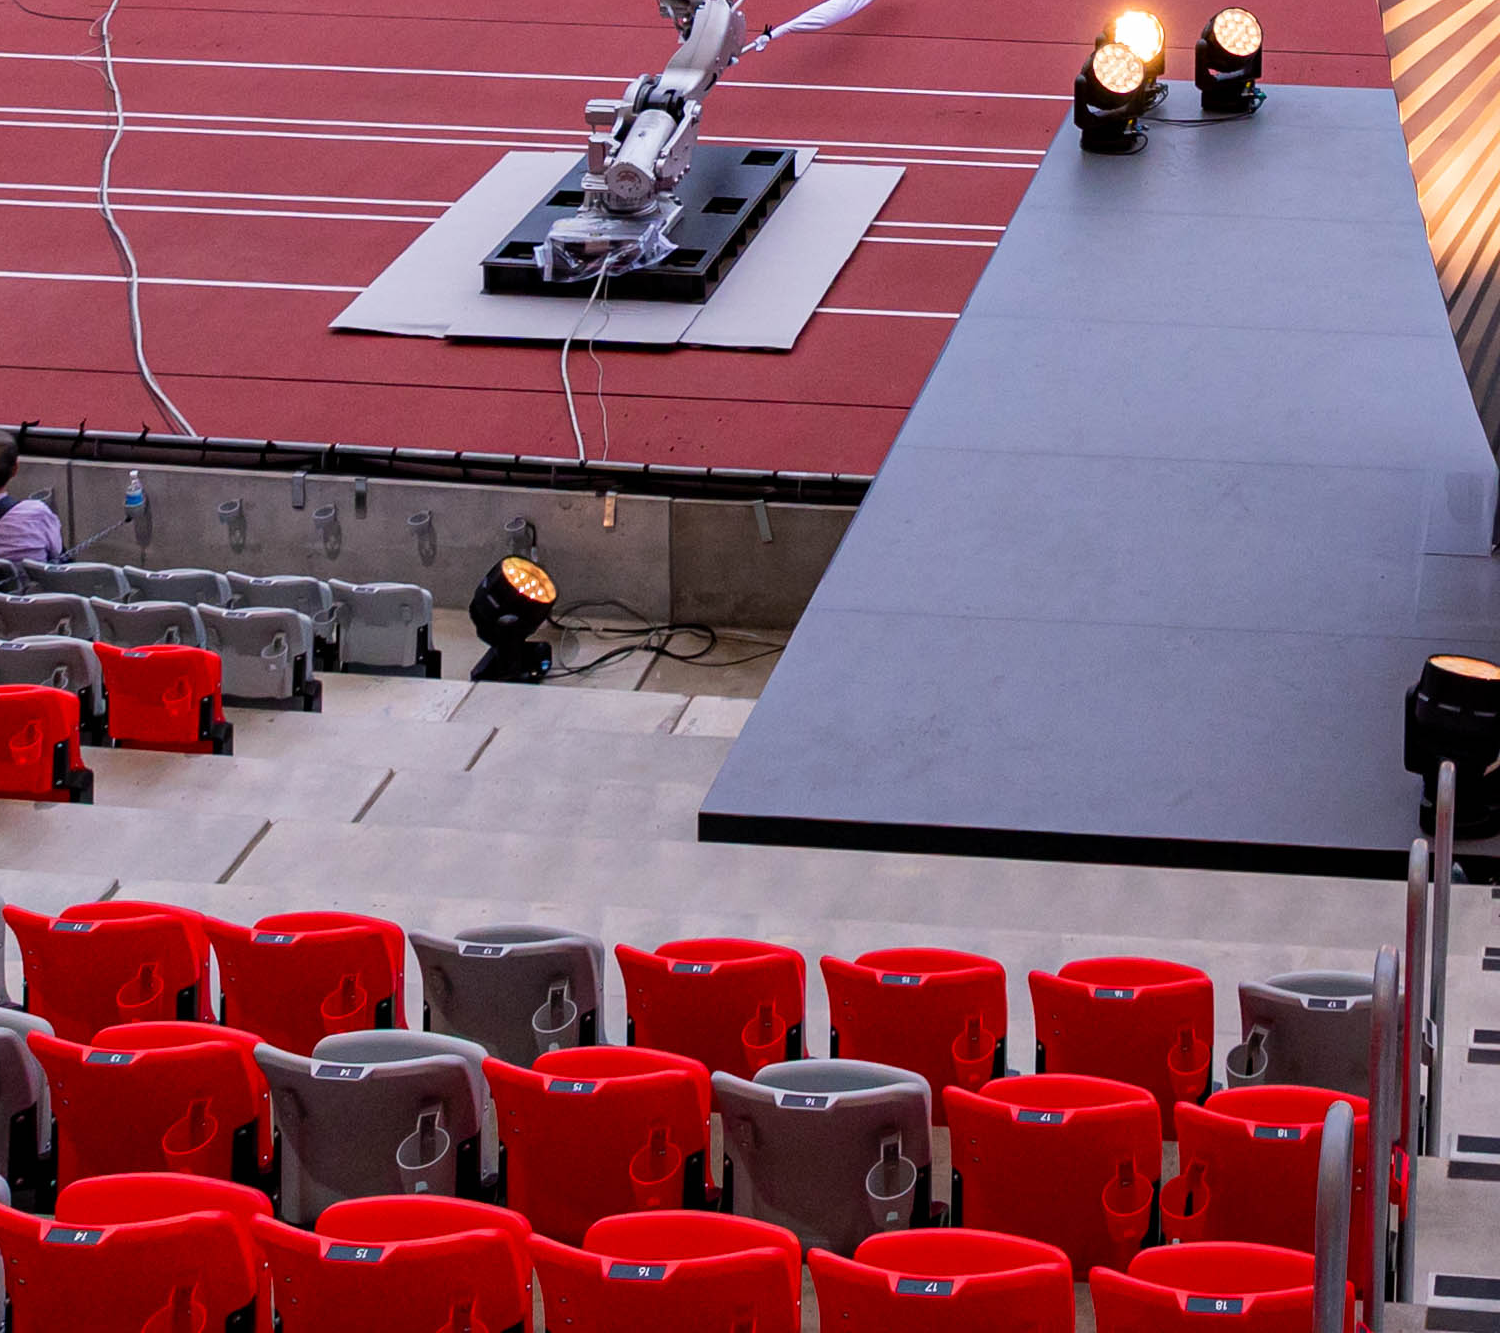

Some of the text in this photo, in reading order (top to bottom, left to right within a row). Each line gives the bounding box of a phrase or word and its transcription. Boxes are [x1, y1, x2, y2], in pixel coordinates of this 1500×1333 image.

[110, 1054, 121, 1062] 13
[573, 1083, 583, 1091] 15
[74, 1232, 87, 1241] 14
[356, 1249, 368, 1258] 15
[639, 1267, 650, 1276] 16
[925, 1282, 937, 1292] 17
[1216, 1301, 1227, 1310] 18
